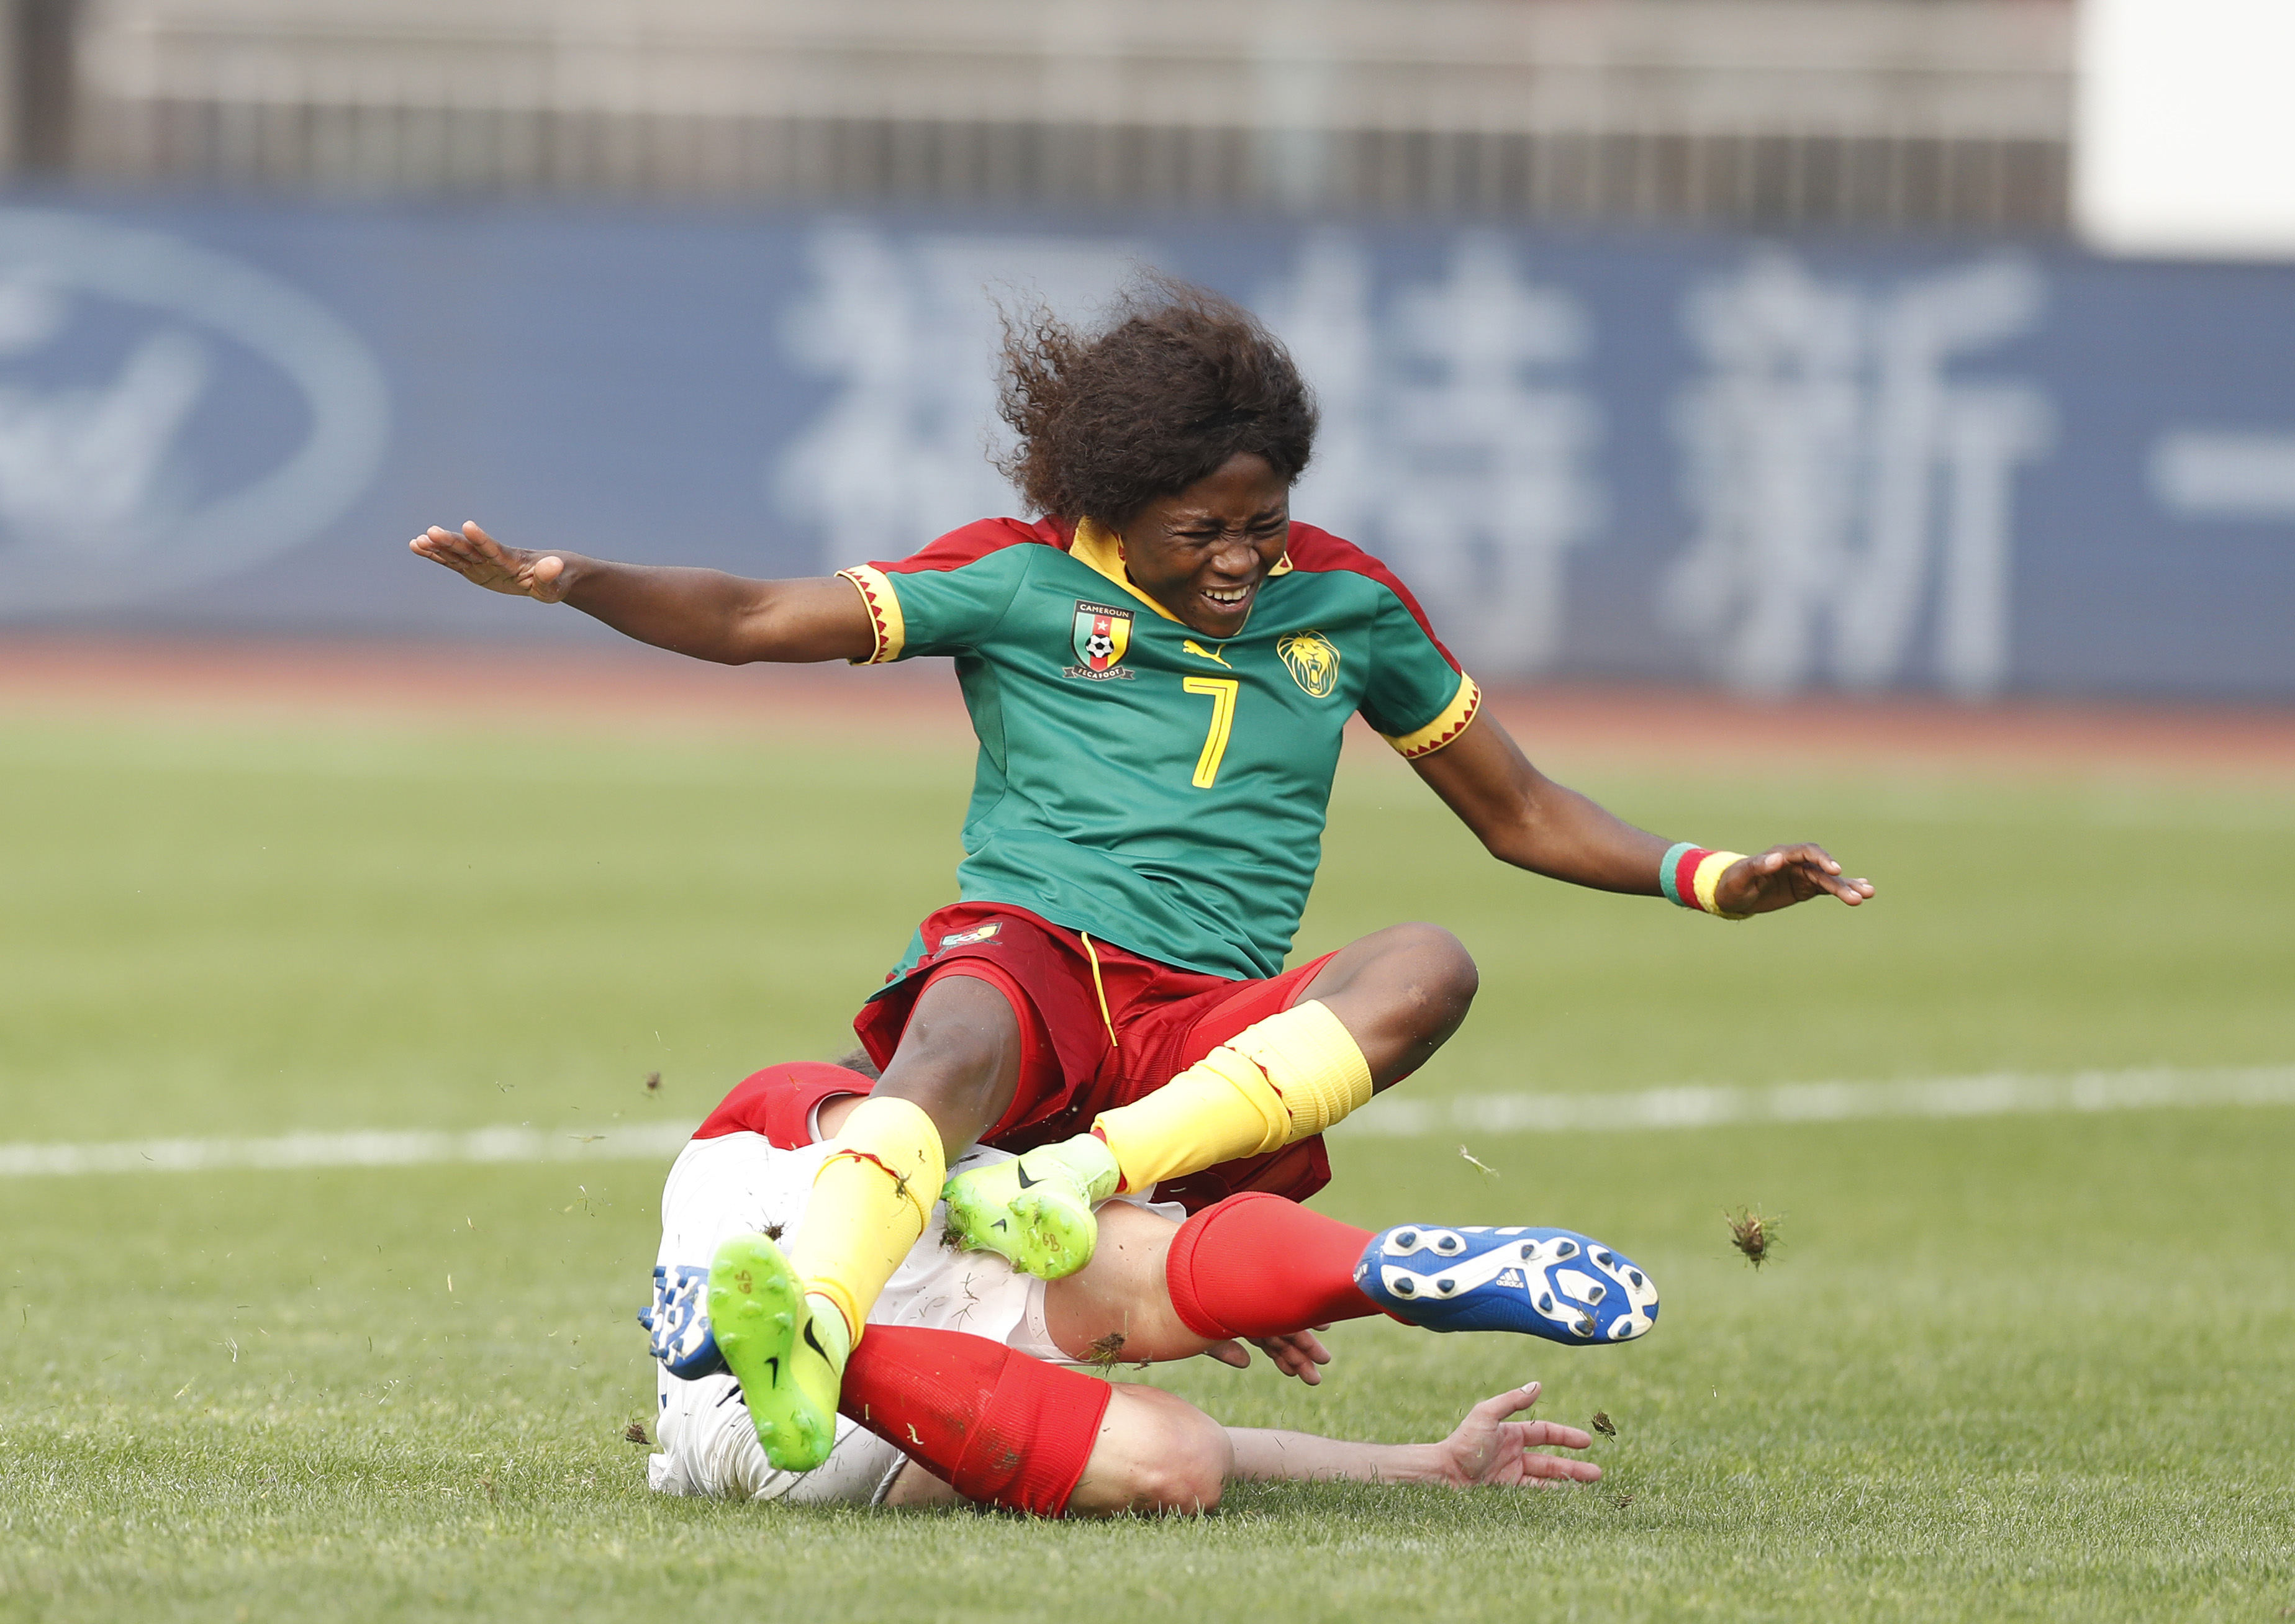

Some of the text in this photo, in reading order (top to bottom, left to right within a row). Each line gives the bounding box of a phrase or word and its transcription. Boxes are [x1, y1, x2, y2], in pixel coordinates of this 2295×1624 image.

[1080, 604, 1129, 618] CAMEROUN
[1078, 668, 1120, 679] FECAFOOT
[1183, 677, 1239, 788] 7
[1496, 1279, 1524, 1288] adidas
